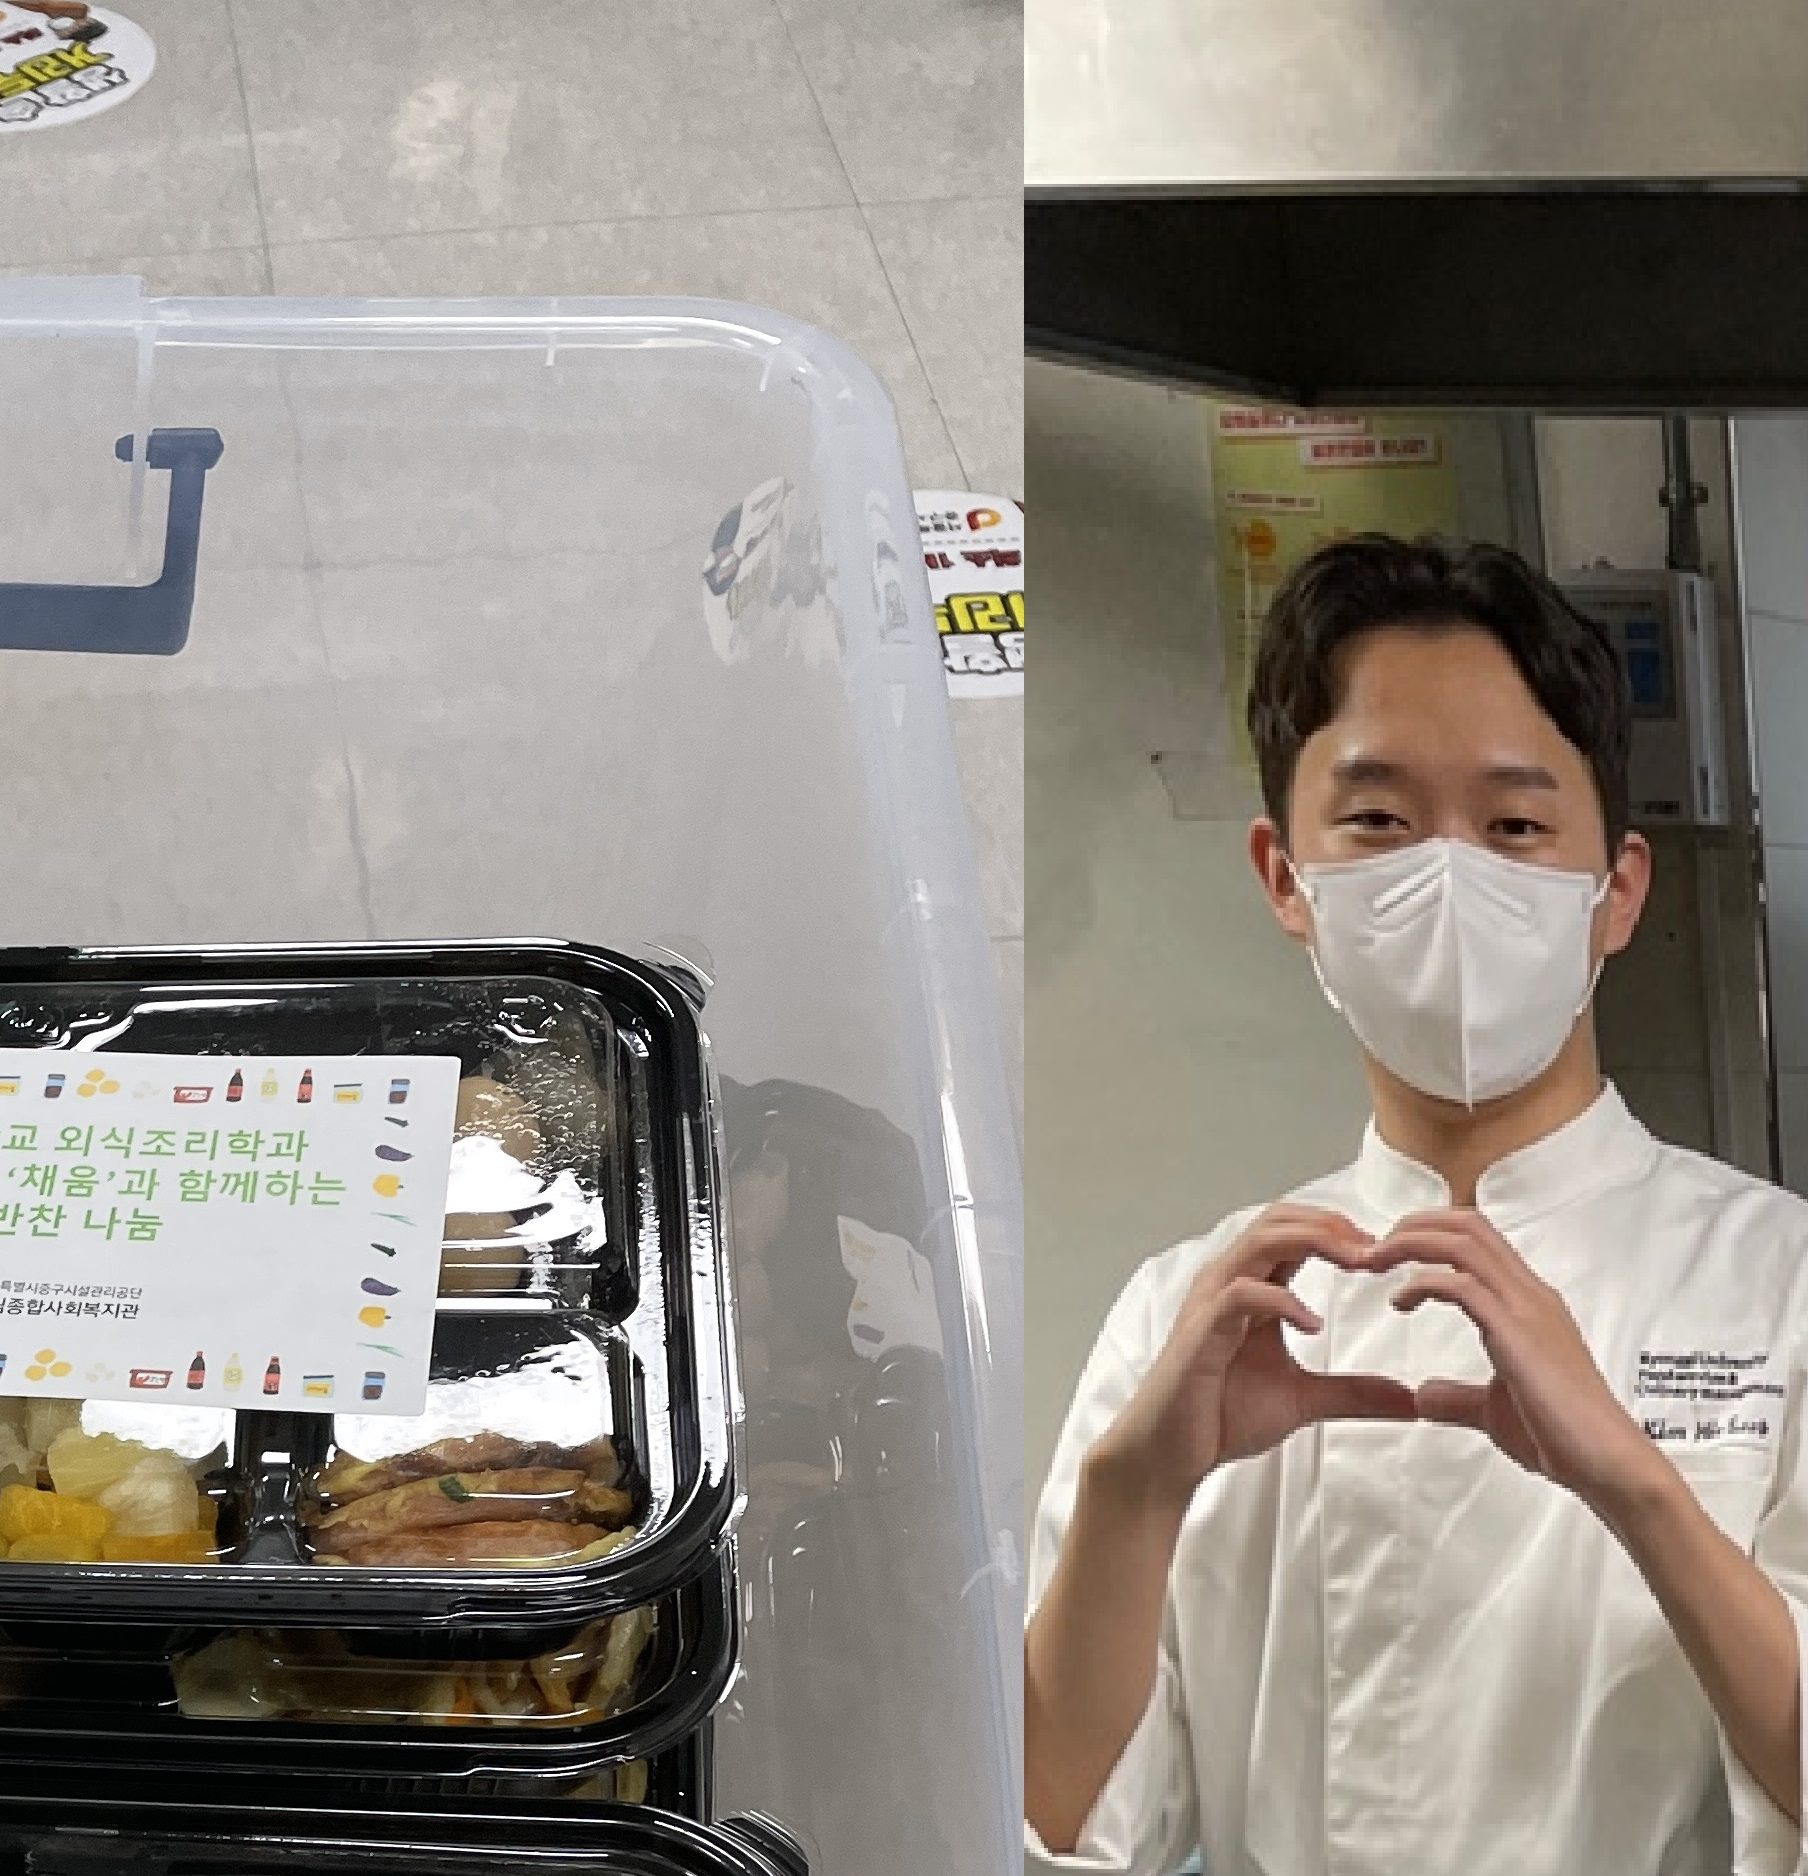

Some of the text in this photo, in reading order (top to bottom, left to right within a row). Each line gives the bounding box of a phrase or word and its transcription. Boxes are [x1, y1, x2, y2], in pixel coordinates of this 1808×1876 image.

[52, 1123, 310, 1163] 외식조리학과
[178, 1168, 346, 1206] 함께하는
[81, 1205, 164, 1242] 나눔
